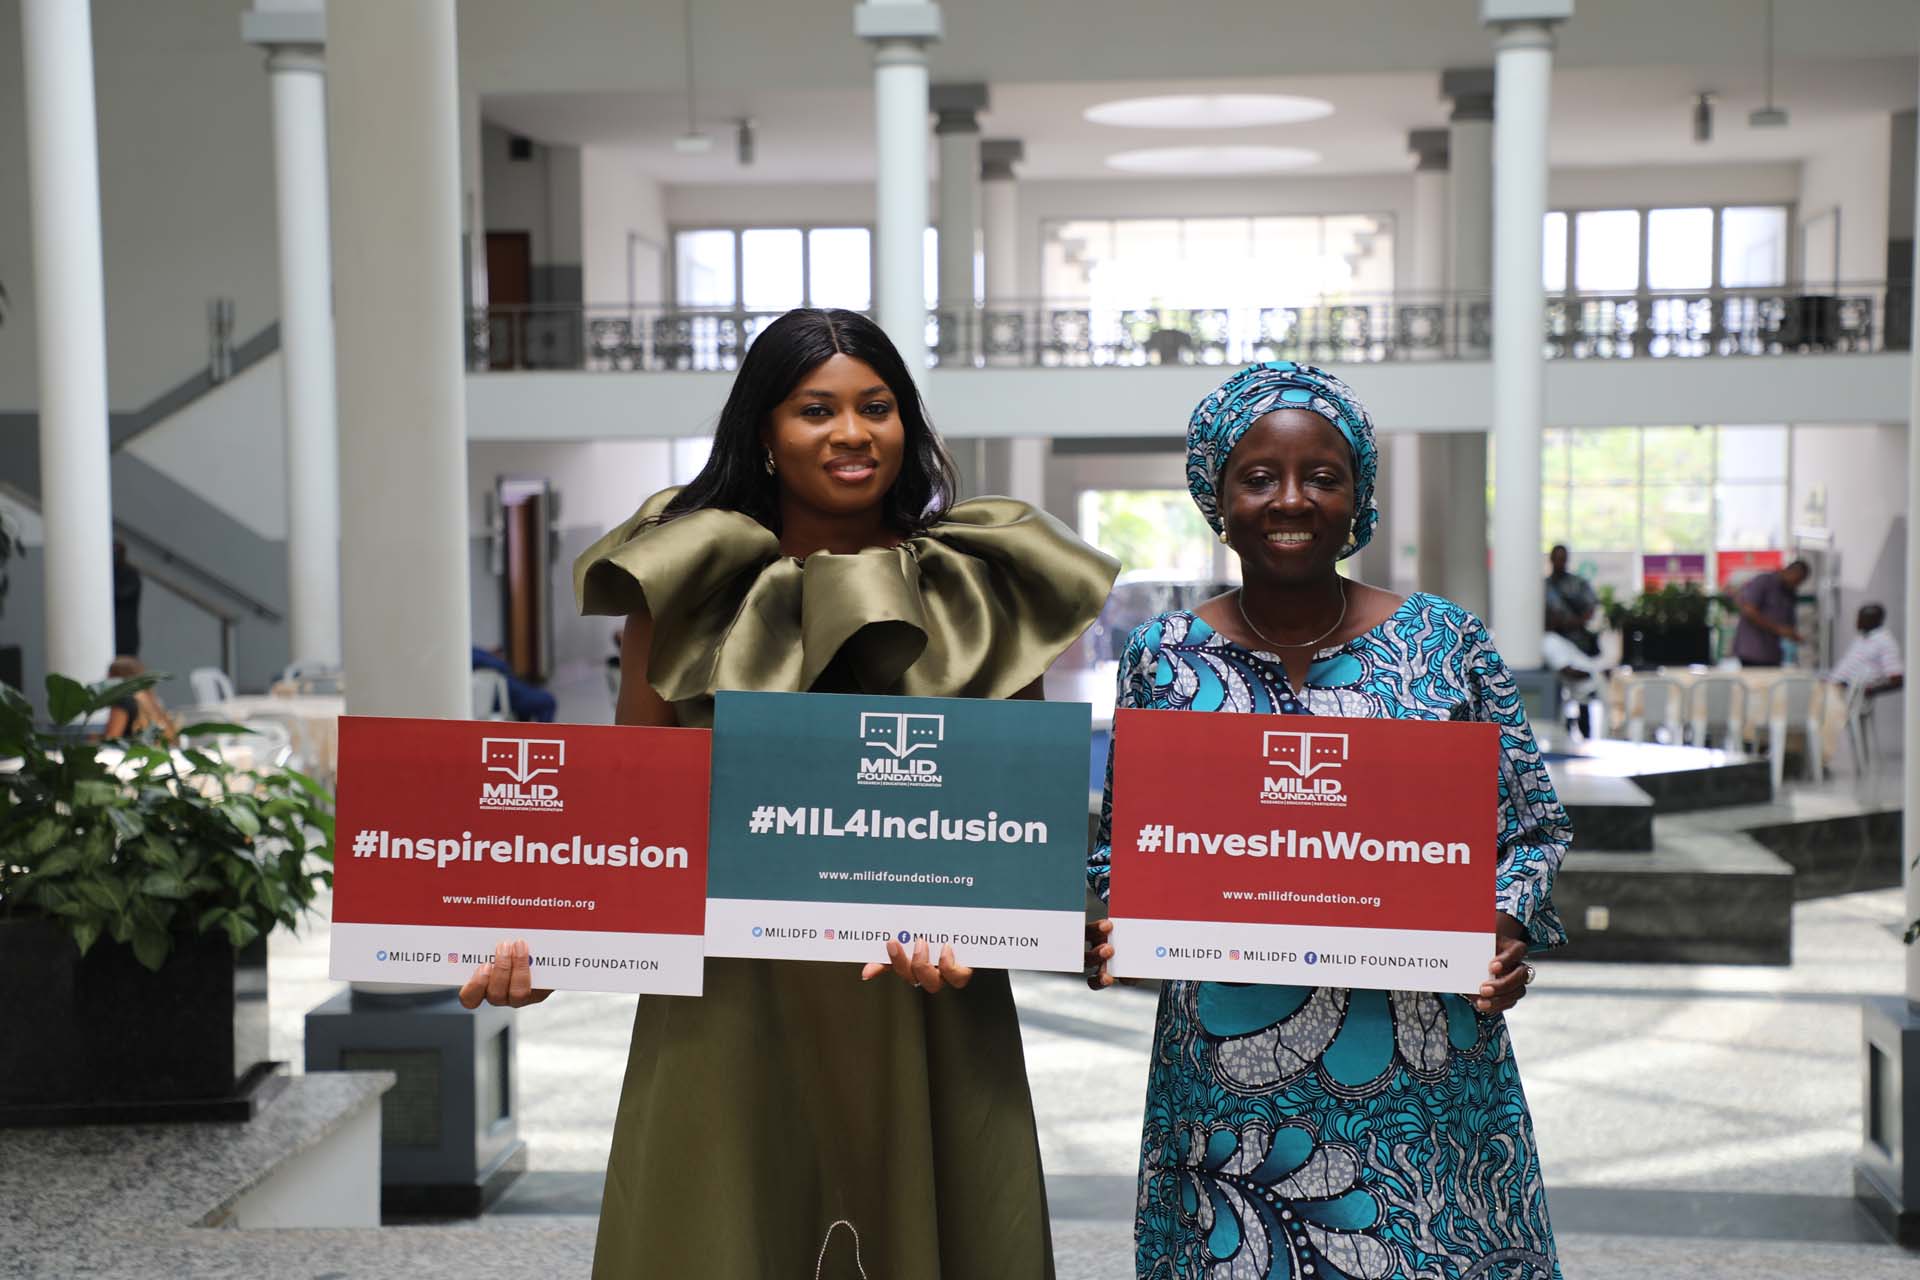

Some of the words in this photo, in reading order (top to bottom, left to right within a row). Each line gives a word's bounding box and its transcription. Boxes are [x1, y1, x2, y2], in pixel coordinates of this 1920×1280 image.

[860, 757, 937, 775] MILID
[856, 772, 942, 783] FOUNDATION
[1263, 776, 1342, 795] MILID
[482, 782, 559, 800] MILID
[1260, 791, 1347, 803] FOUNDATION
[479, 797, 564, 808] FOUNDATION
[749, 805, 1048, 844] #MIL4Inclusion
[352, 829, 689, 869] #InspireInclusion
[1137, 824, 1471, 865] #InvestInWomen
[818, 870, 975, 887] www.milidfoundation.org
[442, 893, 596, 911] www.milidfoundation.org
[1222, 889, 1381, 907] www.milidfoundation.org
[764, 926, 818, 940] MILIDFD
[838, 930, 892, 943] MILIDFD
[913, 932, 950, 944] MILID
[952, 934, 1039, 948] FOUNDATION
[388, 951, 442, 964] MILIDFD
[461, 954, 496, 965] MILID
[535, 956, 571, 968] MILID
[574, 958, 660, 971] FOUNDATION
[1168, 947, 1223, 961] MILIDFD
[1243, 950, 1298, 963] MILIDFD
[1319, 953, 1357, 966] MILID
[1360, 955, 1449, 969] FOUNDATION
